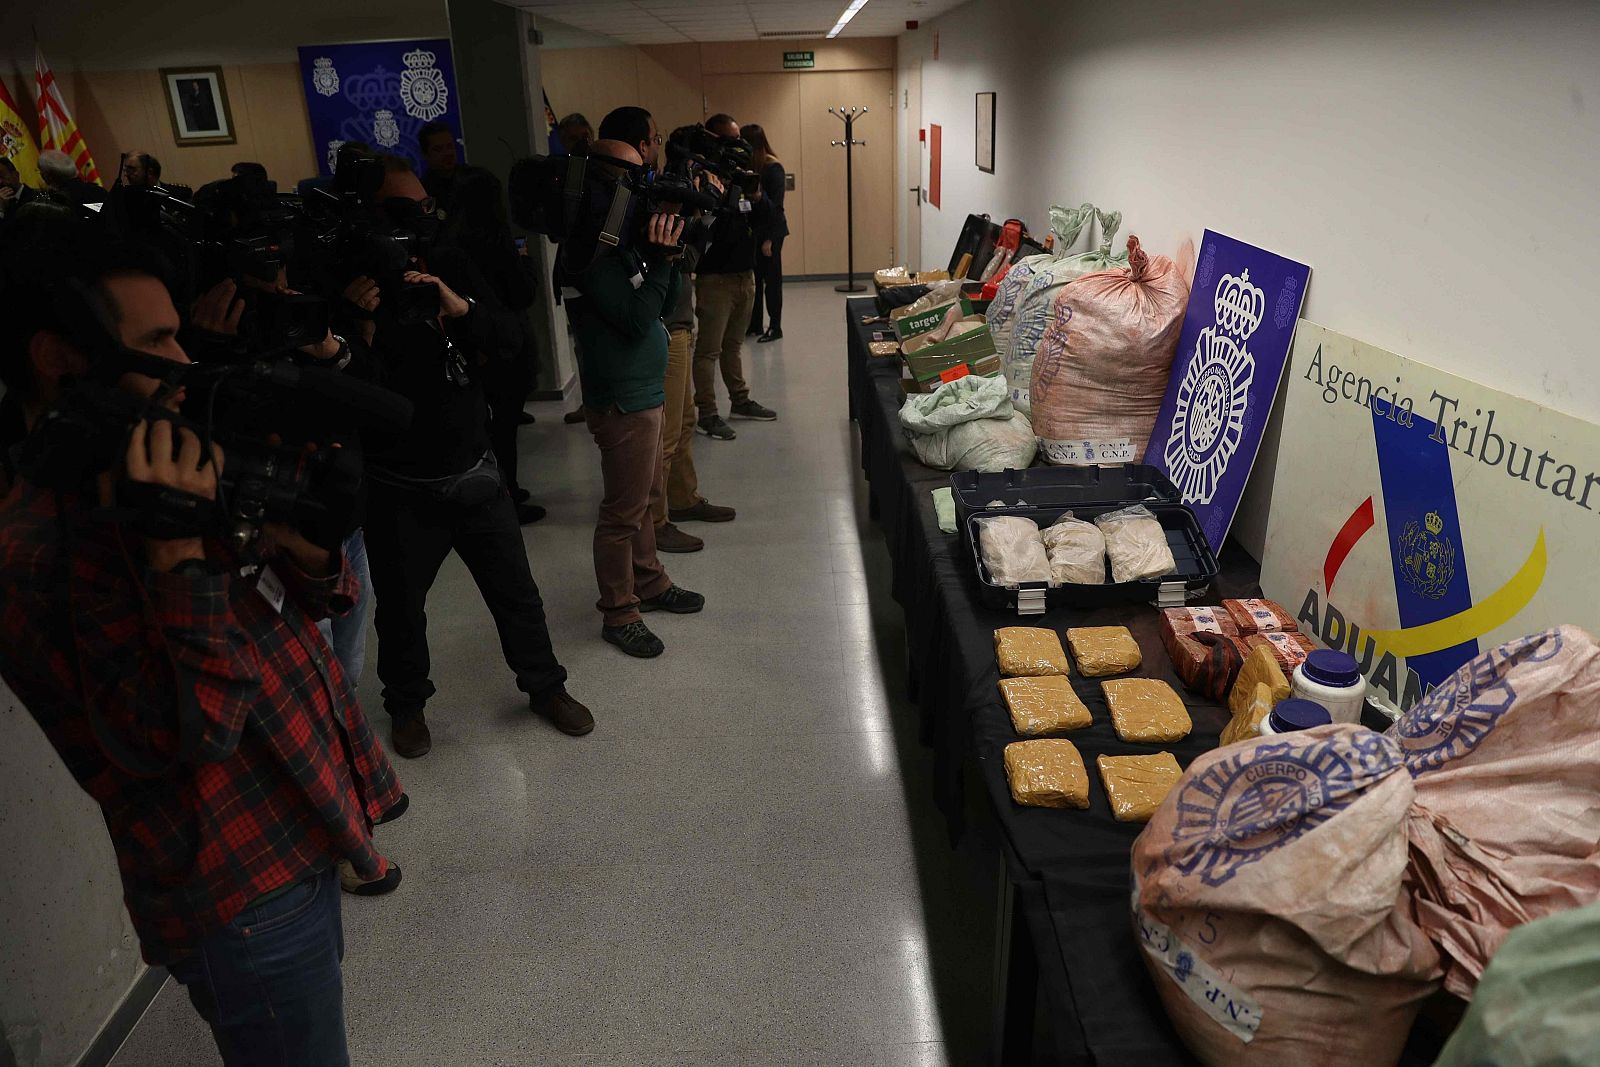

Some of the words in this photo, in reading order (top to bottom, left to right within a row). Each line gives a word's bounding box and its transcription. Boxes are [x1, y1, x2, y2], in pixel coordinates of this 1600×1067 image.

[909, 314, 940, 330] target
[1195, 366, 1215, 393] CUERPO
[1214, 365, 1230, 399] NACIONAL
[1303, 342, 1414, 429] Agencia
[1428, 389, 1600, 512] Tributar
[1101, 450, 1130, 459] C.N.P.
[1435, 720, 1453, 739] DE
[1245, 762, 1308, 783] CUERPO
